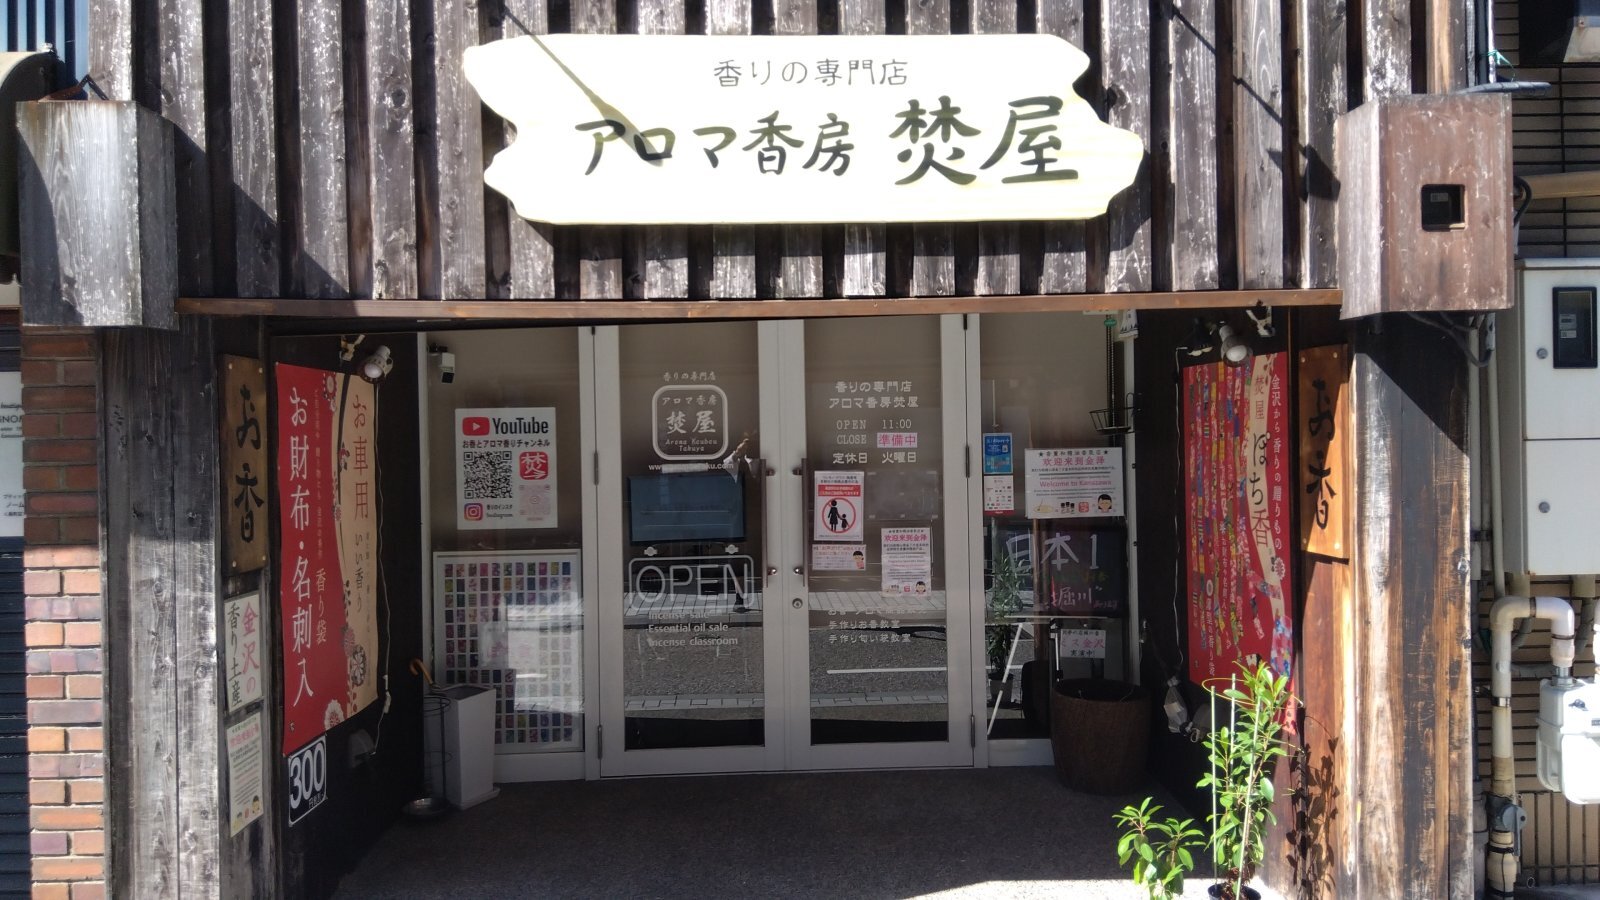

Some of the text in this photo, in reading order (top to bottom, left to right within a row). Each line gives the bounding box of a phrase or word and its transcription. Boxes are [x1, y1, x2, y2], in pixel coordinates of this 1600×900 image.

[712, 59, 908, 87] 香りの専門店
[575, 95, 1079, 186] アロマ香房 焚屋
[662, 371, 717, 382] 香りの専門店
[835, 381, 913, 393] 香りの専門店
[661, 394, 718, 406] アロマ香房
[828, 396, 919, 409] アロマ香房焚屋
[1254, 376, 1266, 420] 焚屋
[492, 416, 549, 435] YouTube
[665, 410, 716, 434] 焚屋
[836, 418, 912, 430] OPEN 11:00
[836, 434, 867, 445] CLOSE
[879, 434, 916, 447] 準備中
[832, 451, 917, 464] 定休日 火曜日
[1306, 378, 1336, 530] お香
[234, 384, 265, 543] お香
[636, 563, 748, 603] OPEN
[649, 622, 729, 633] Essential oil sale
[242, 602, 260, 695] 金沢の
[690, 636, 738, 646] classroom
[290, 741, 326, 809] 300
